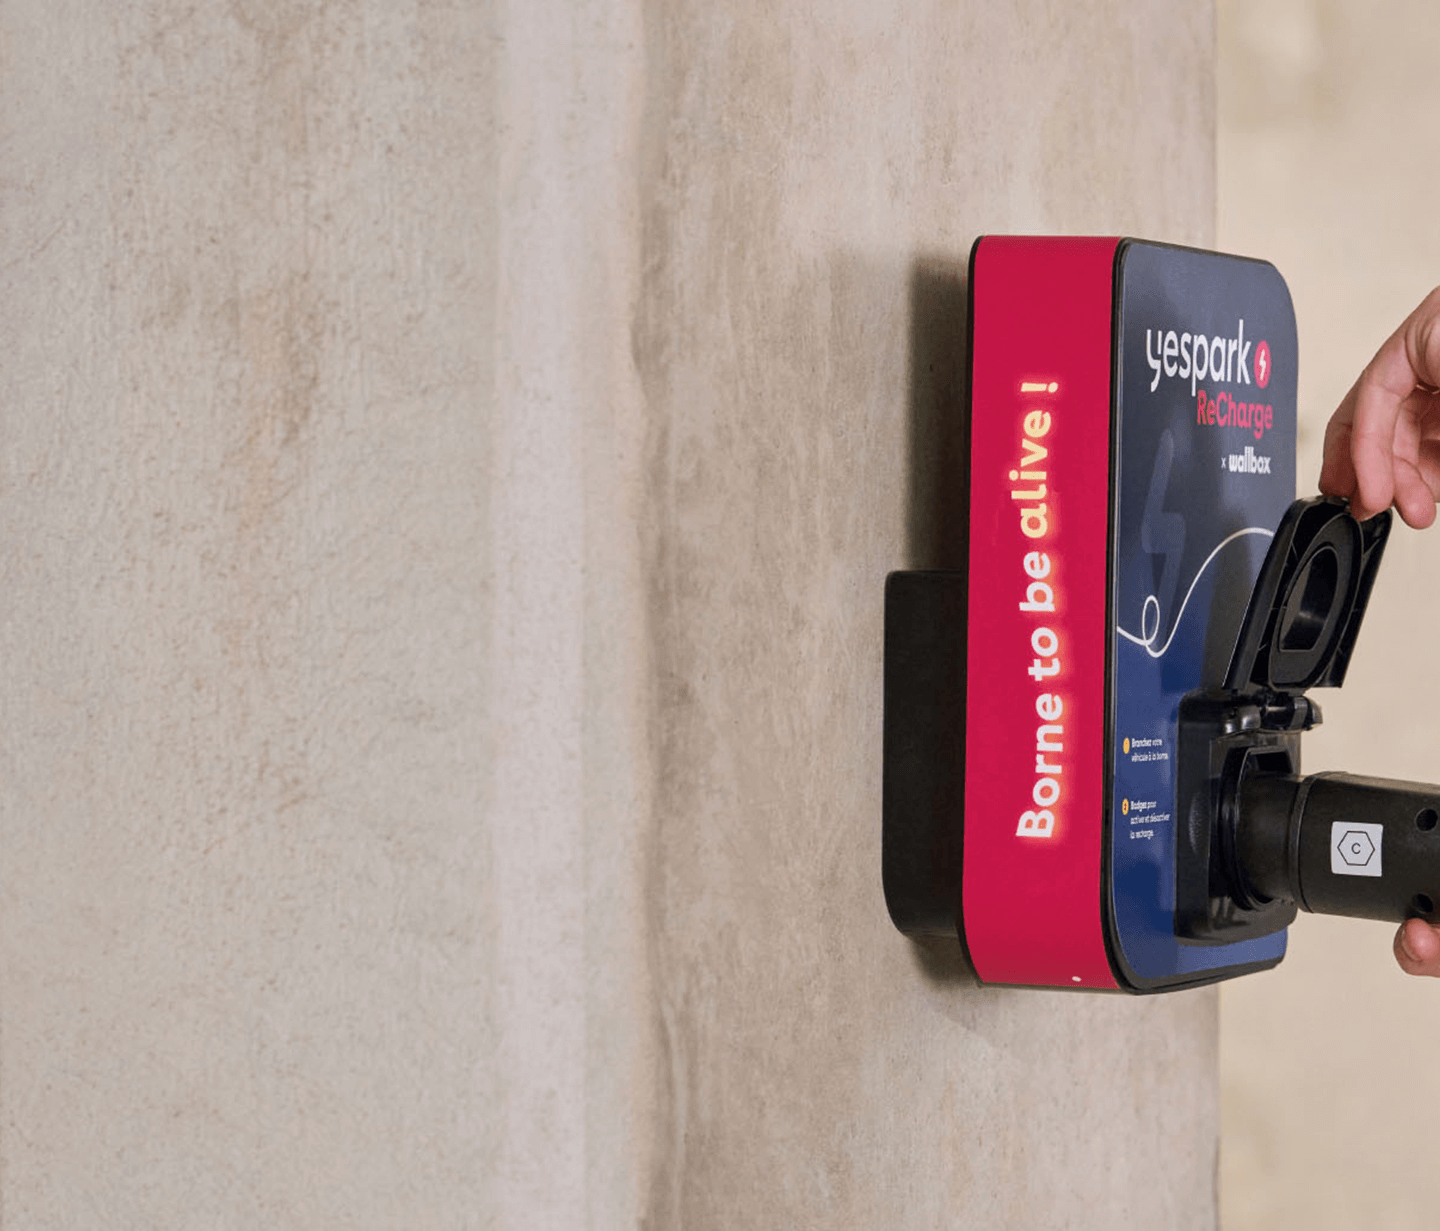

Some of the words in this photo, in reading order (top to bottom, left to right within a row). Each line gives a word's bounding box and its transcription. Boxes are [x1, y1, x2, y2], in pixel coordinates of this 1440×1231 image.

[1146, 319, 1251, 397] yespark
[1020, 382, 1059, 393] !
[1197, 390, 1273, 439] ReCharge
[1009, 410, 1052, 538] alive
[1228, 446, 1271, 474] wallbox
[1019, 551, 1056, 612] be
[1028, 627, 1061, 681] to
[1016, 693, 1064, 838] Borne
[1351, 842, 1361, 854] C
